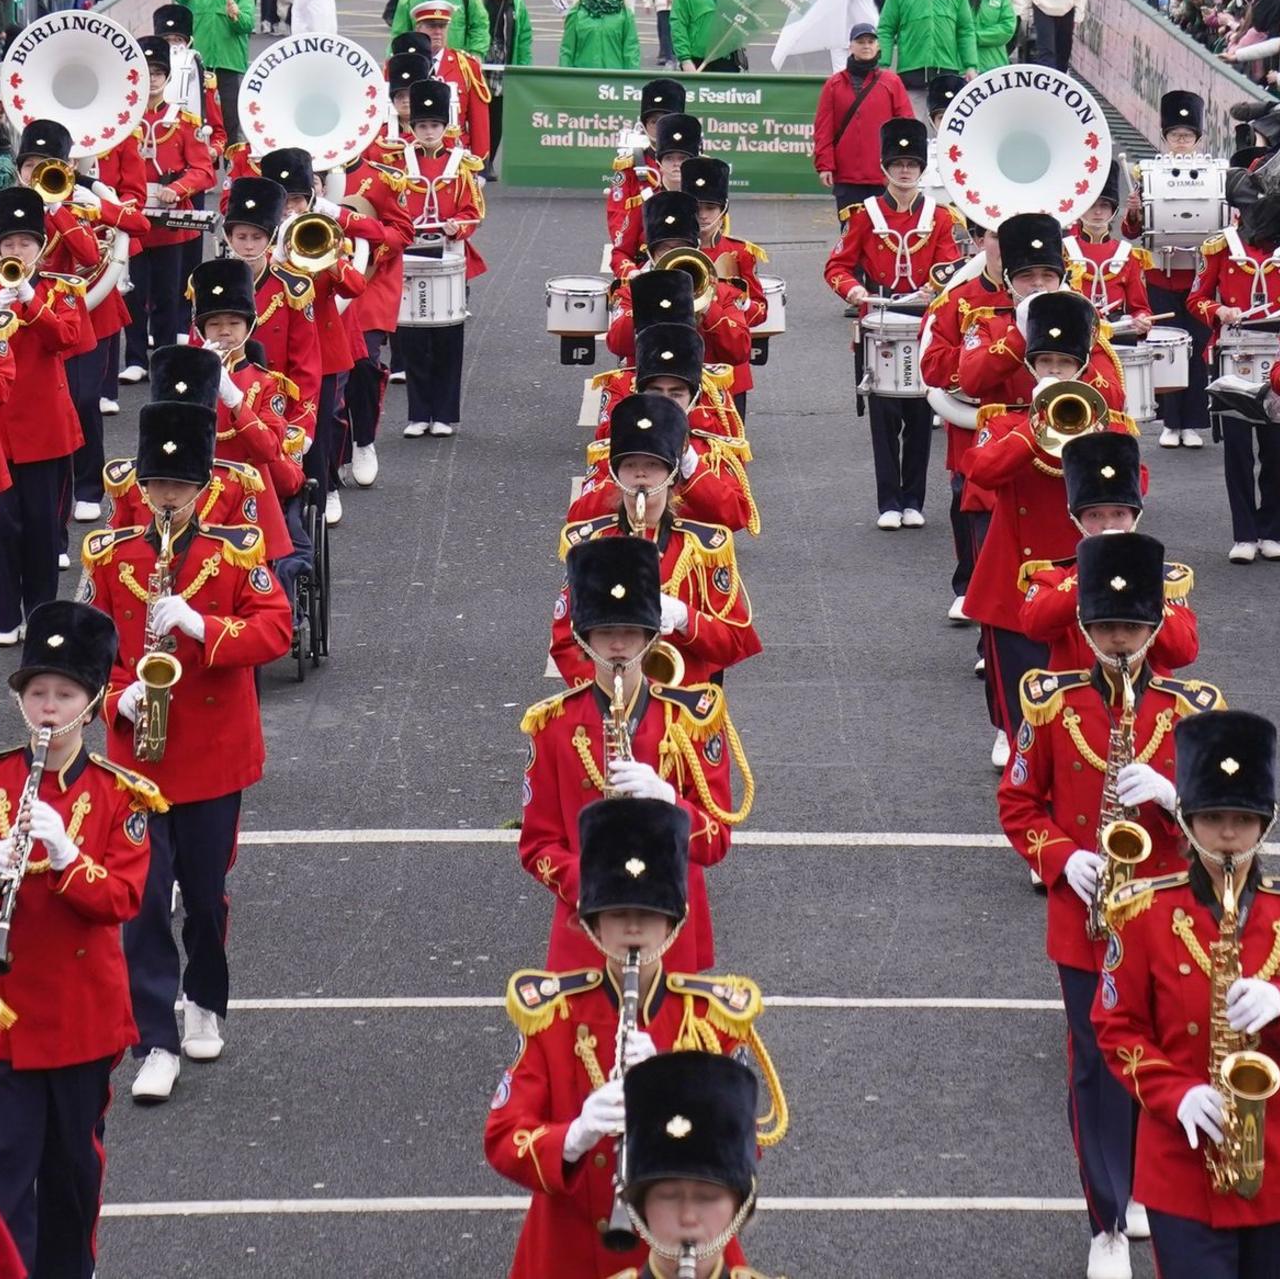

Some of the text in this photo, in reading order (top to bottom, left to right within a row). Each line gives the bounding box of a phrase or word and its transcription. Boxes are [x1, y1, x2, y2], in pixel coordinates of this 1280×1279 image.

[9, 14, 138, 65] BURLINGTON
[247, 37, 374, 94] BURLINGTON
[598, 85, 618, 101] St.
[699, 87, 761, 105] Festival
[946, 68, 1098, 136] BURLINGTON
[532, 112, 553, 129] St.
[557, 113, 632, 131] Patrick's
[707, 118, 759, 135] Dance
[763, 119, 815, 141] Troup
[540, 131, 815, 158] and Dubli nce Academy
[1175, 179, 1205, 188] YAMAHA
[417, 287, 428, 319] YAMAHA
[903, 355, 913, 387] YAMAHA
